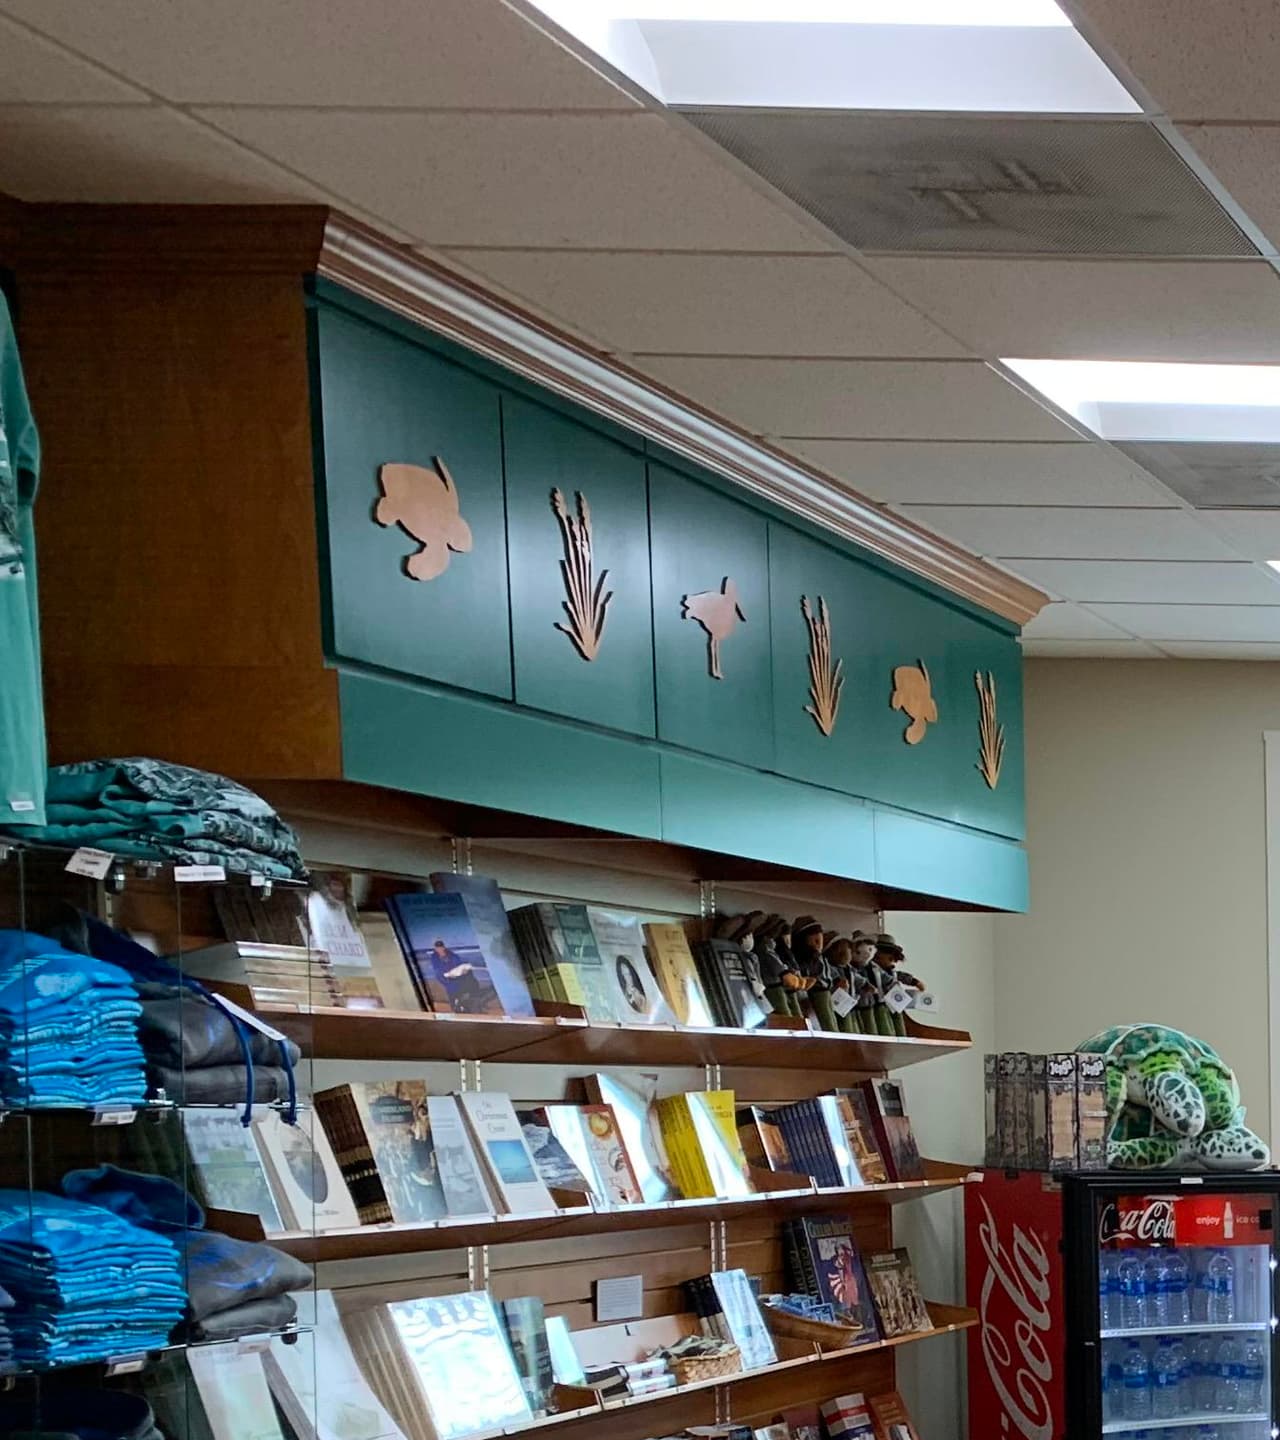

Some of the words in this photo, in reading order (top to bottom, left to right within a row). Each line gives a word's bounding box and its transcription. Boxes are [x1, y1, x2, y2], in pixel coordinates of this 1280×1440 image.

[1100, 1201, 1175, 1243] Ca-Cola
[1195, 1215, 1220, 1227] enjoy
[1236, 1215, 1249, 1224] ice
